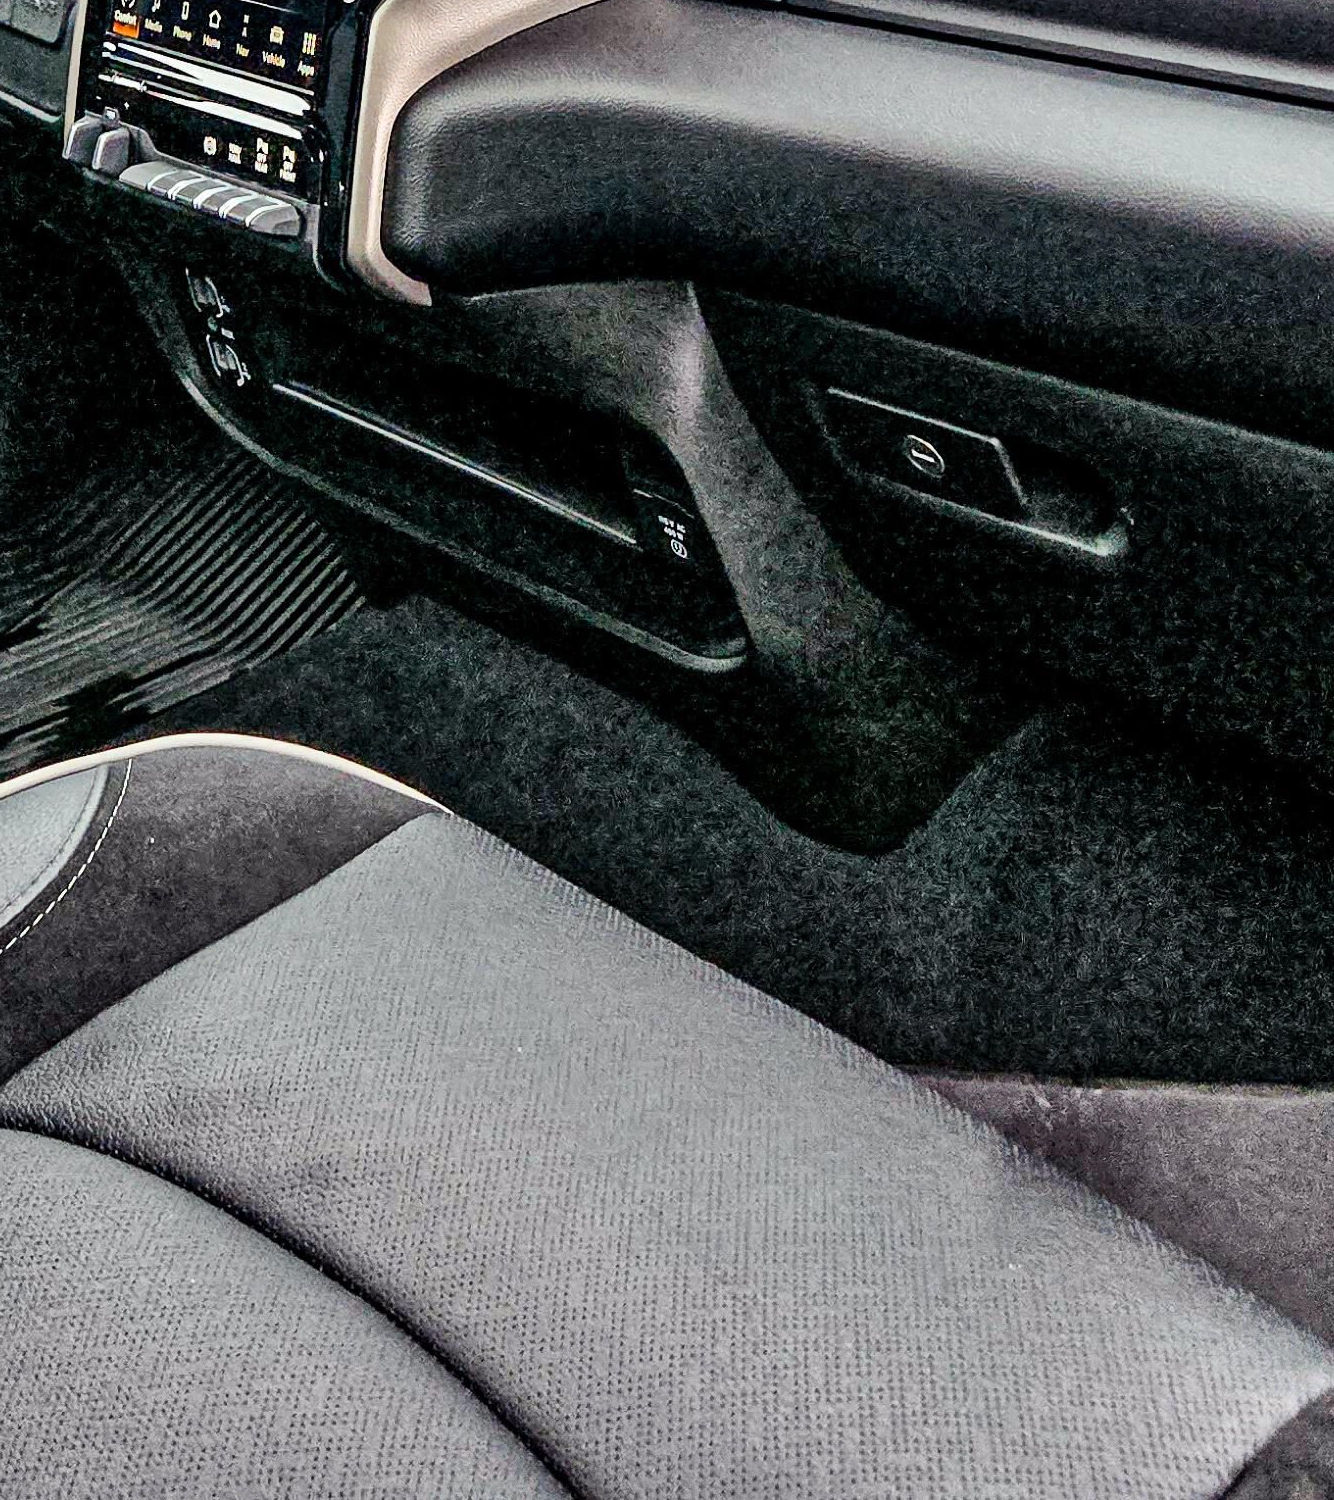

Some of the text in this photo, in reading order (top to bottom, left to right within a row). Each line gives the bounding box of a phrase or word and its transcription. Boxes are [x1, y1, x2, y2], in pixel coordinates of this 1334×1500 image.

[114, 9, 138, 26] Comfort
[173, 25, 193, 43] Phone
[262, 50, 286, 69] Vehicle
